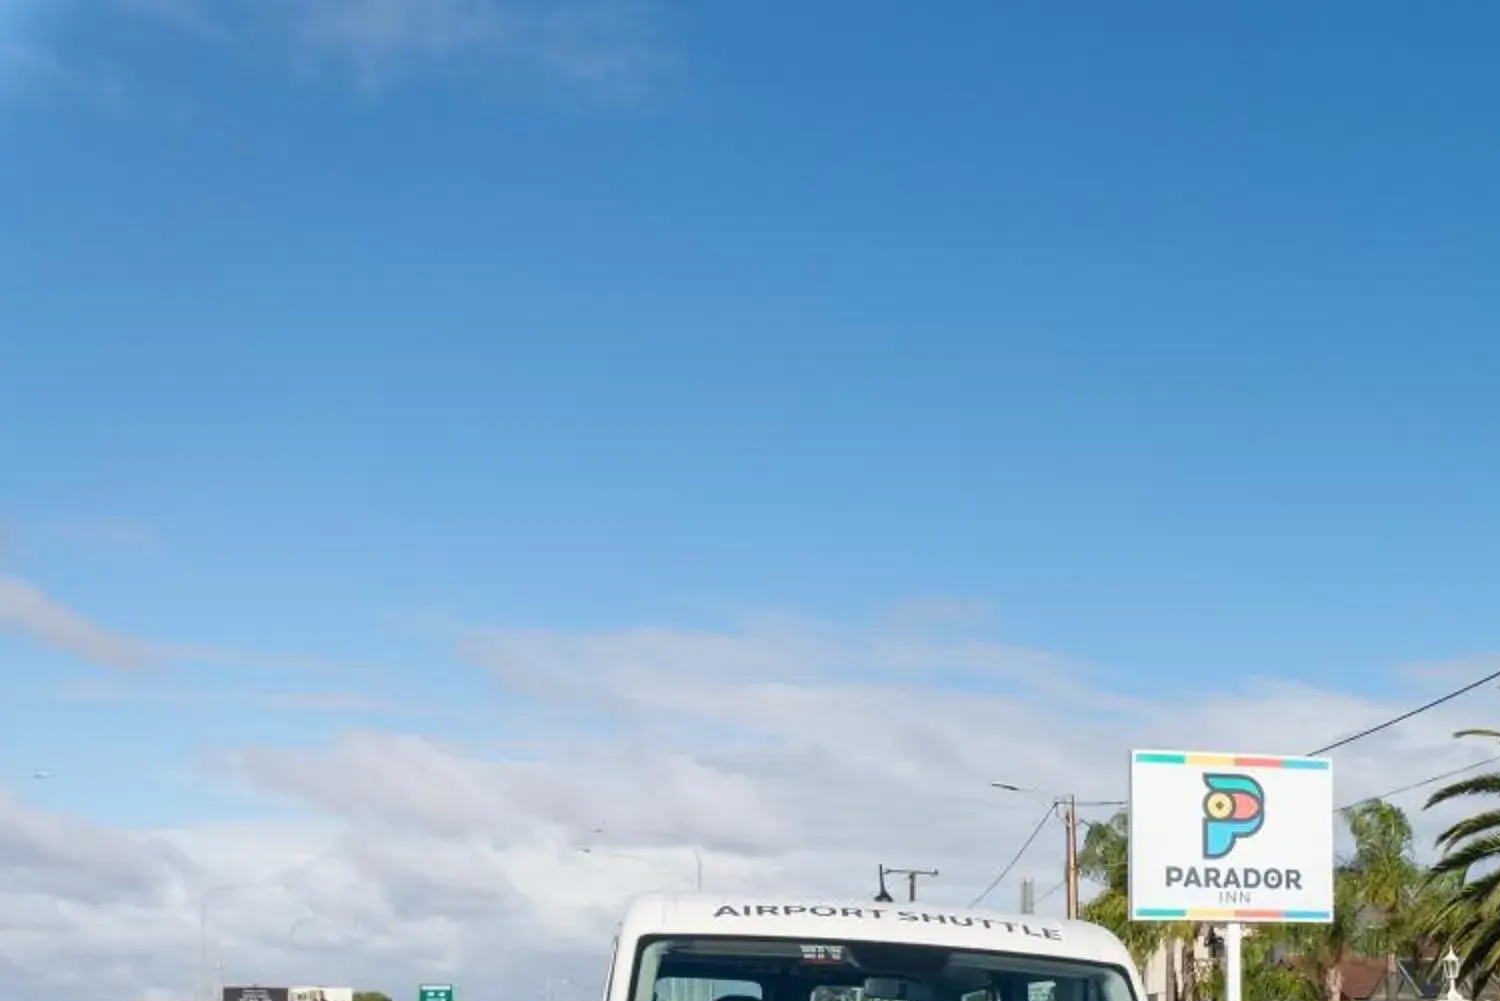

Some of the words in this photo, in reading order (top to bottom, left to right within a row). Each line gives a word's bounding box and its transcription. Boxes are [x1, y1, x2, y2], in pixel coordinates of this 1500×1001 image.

[1165, 865, 1303, 890] PARADOR
[1218, 890, 1252, 905] INN
[713, 904, 888, 919] AIRPORT
[897, 911, 1063, 942] SHUTTLE
